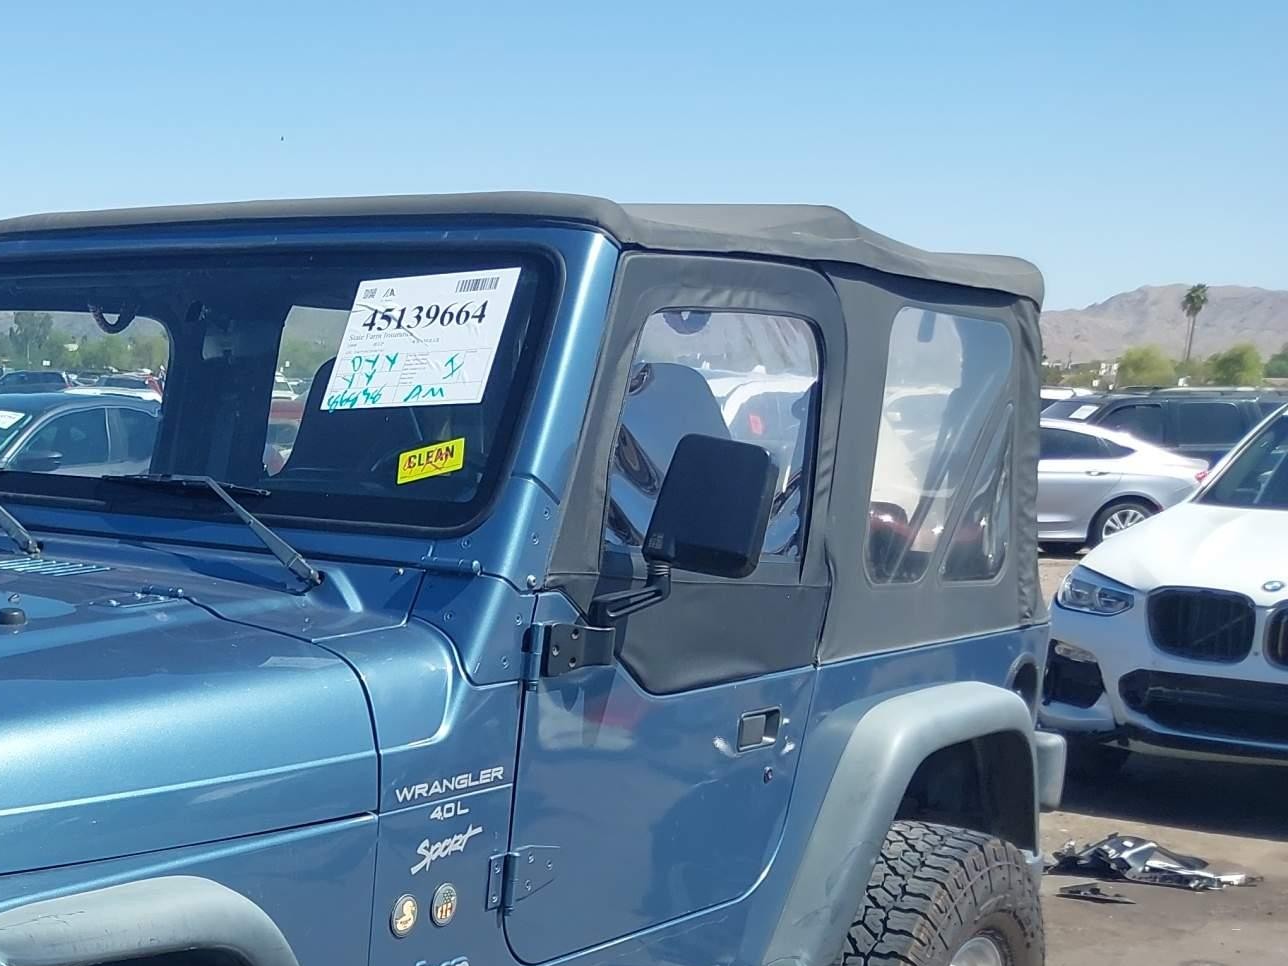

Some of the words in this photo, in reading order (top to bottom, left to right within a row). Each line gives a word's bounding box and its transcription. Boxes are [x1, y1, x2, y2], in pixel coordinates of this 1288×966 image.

[362, 300, 488, 332] 45139664
[406, 445, 455, 469] CLEAN
[395, 766, 504, 803] WRANGLER
[410, 824, 483, 875] Sport
